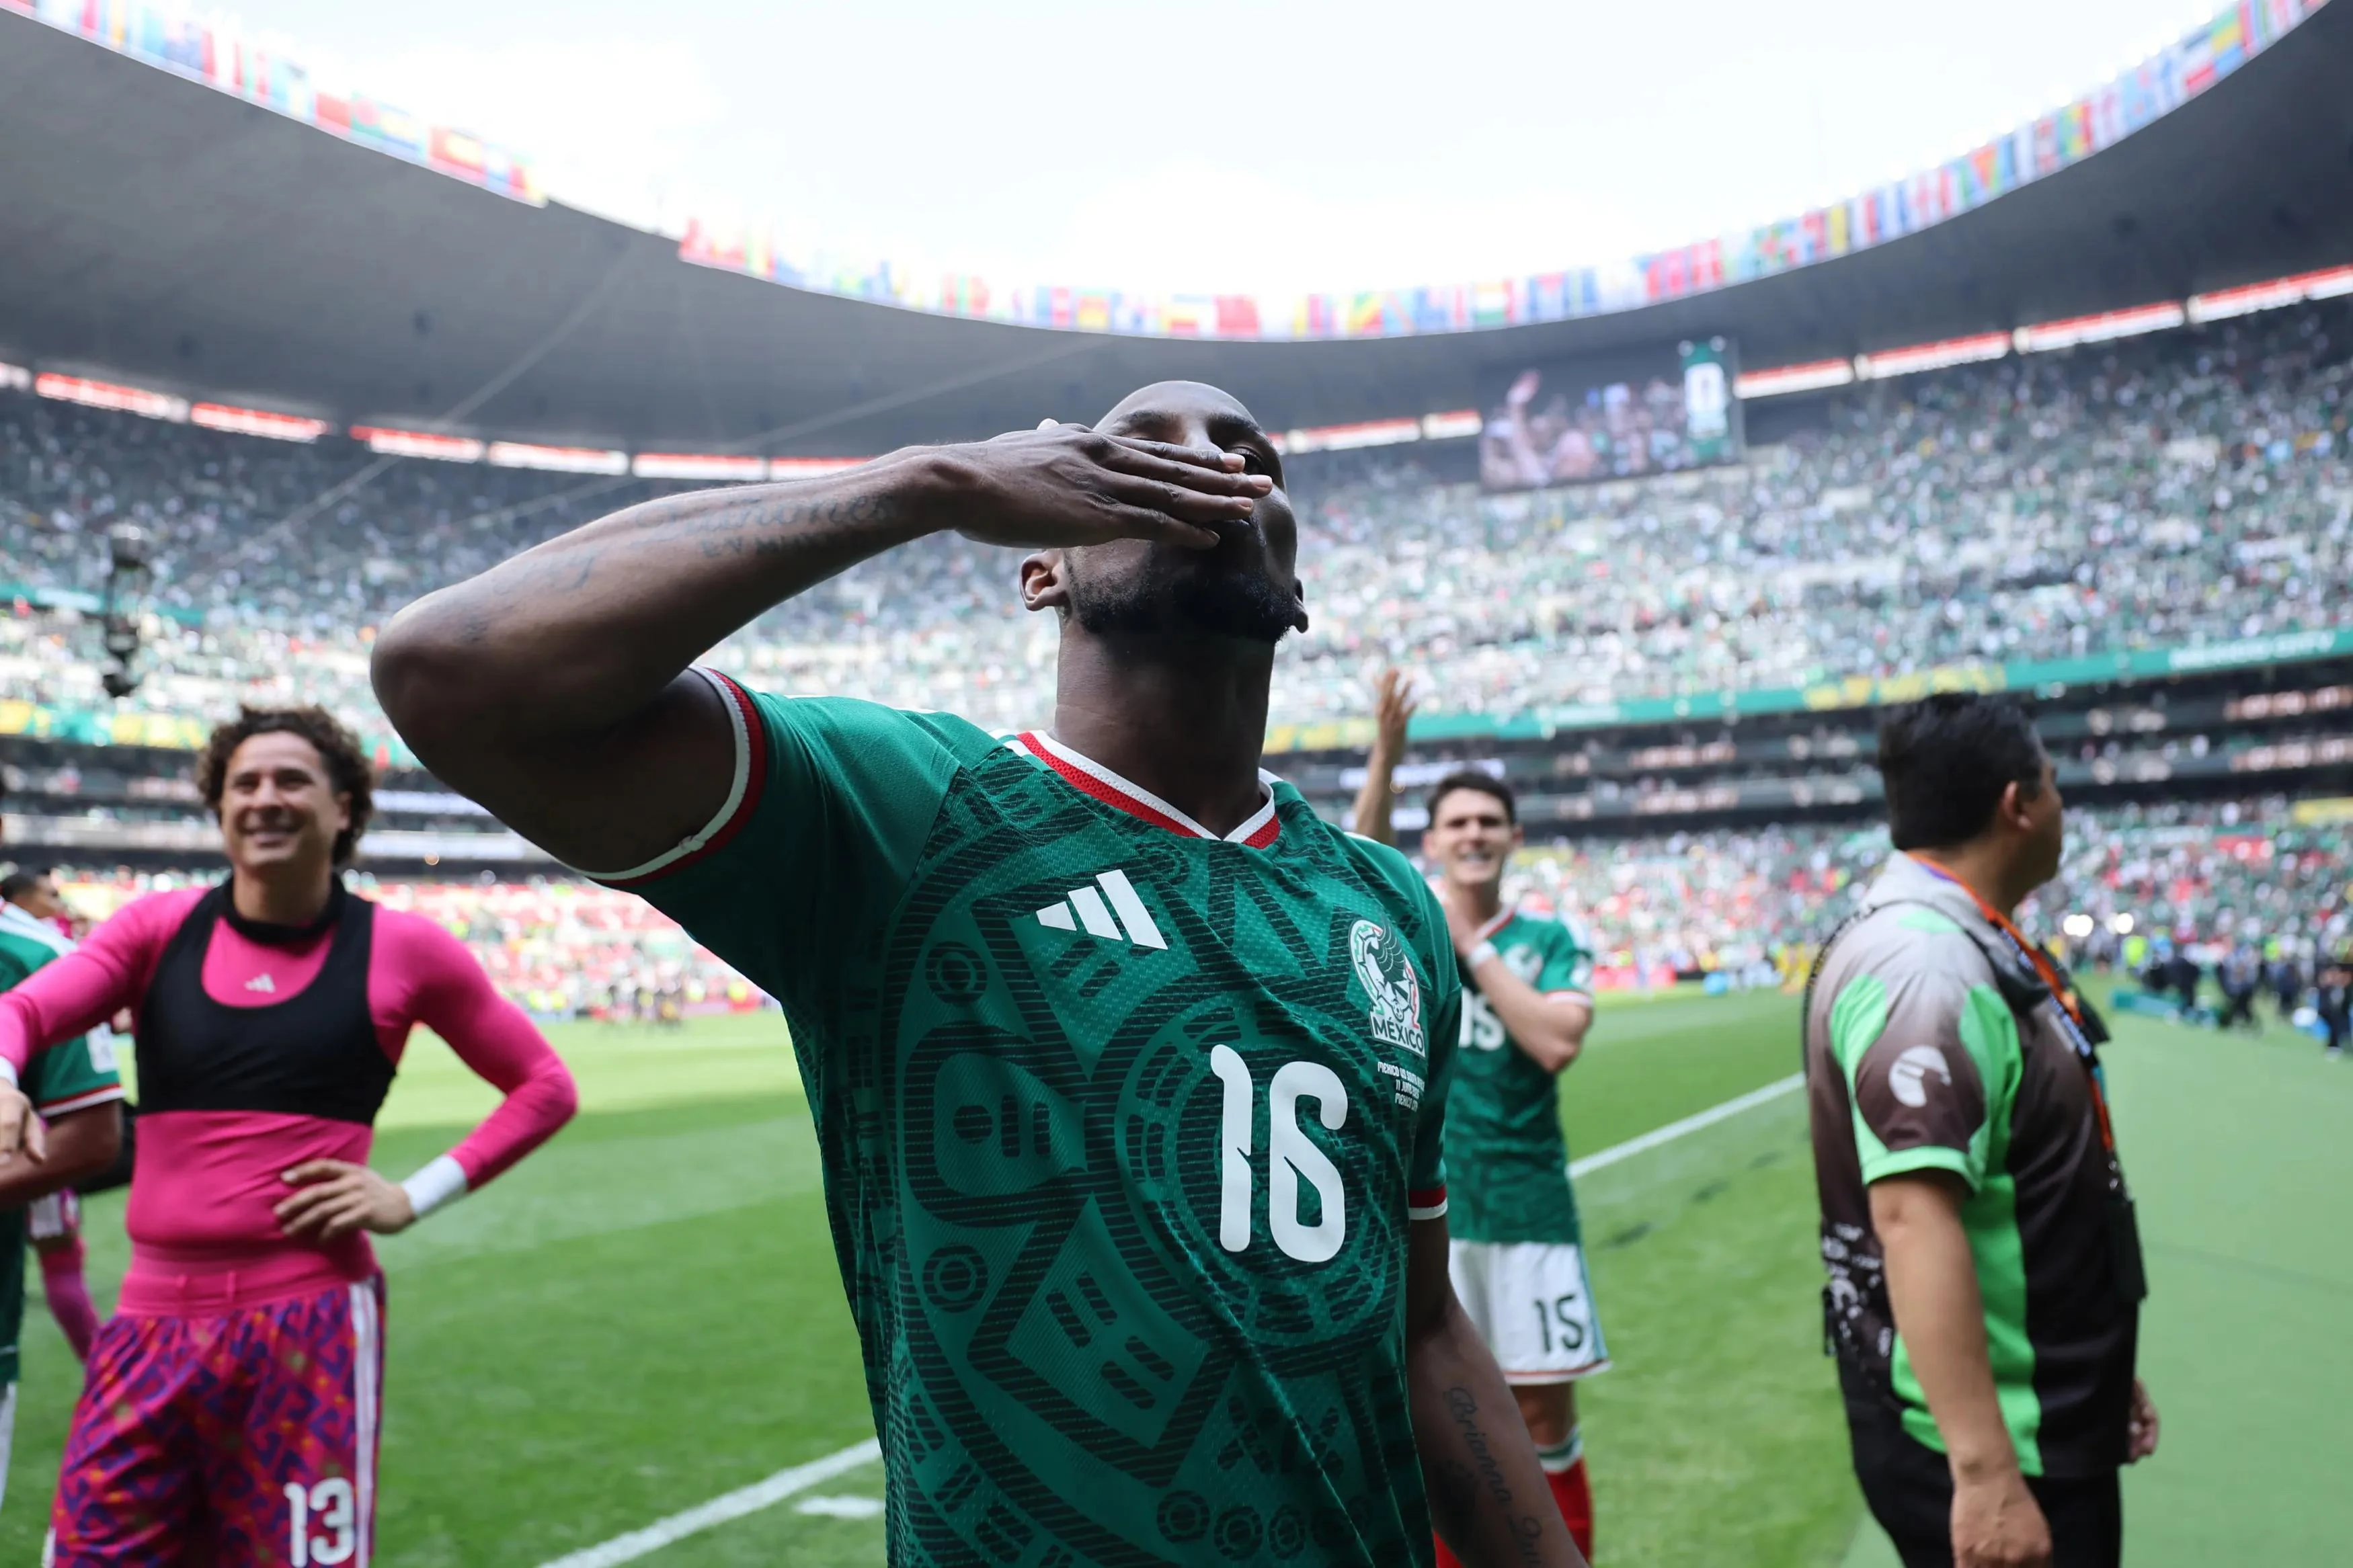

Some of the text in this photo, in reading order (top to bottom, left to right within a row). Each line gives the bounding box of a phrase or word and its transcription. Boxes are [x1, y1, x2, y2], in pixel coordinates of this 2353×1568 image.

[1373, 1016, 1424, 1053] MÉXICO
[1459, 986, 1505, 1051] 15
[1378, 1061, 1400, 1077] MEXICO
[1396, 1079, 1401, 1091] 11
[1210, 1044, 1348, 1262] 16
[1535, 1294, 1585, 1354] 15
[282, 1477, 356, 1568] 13
